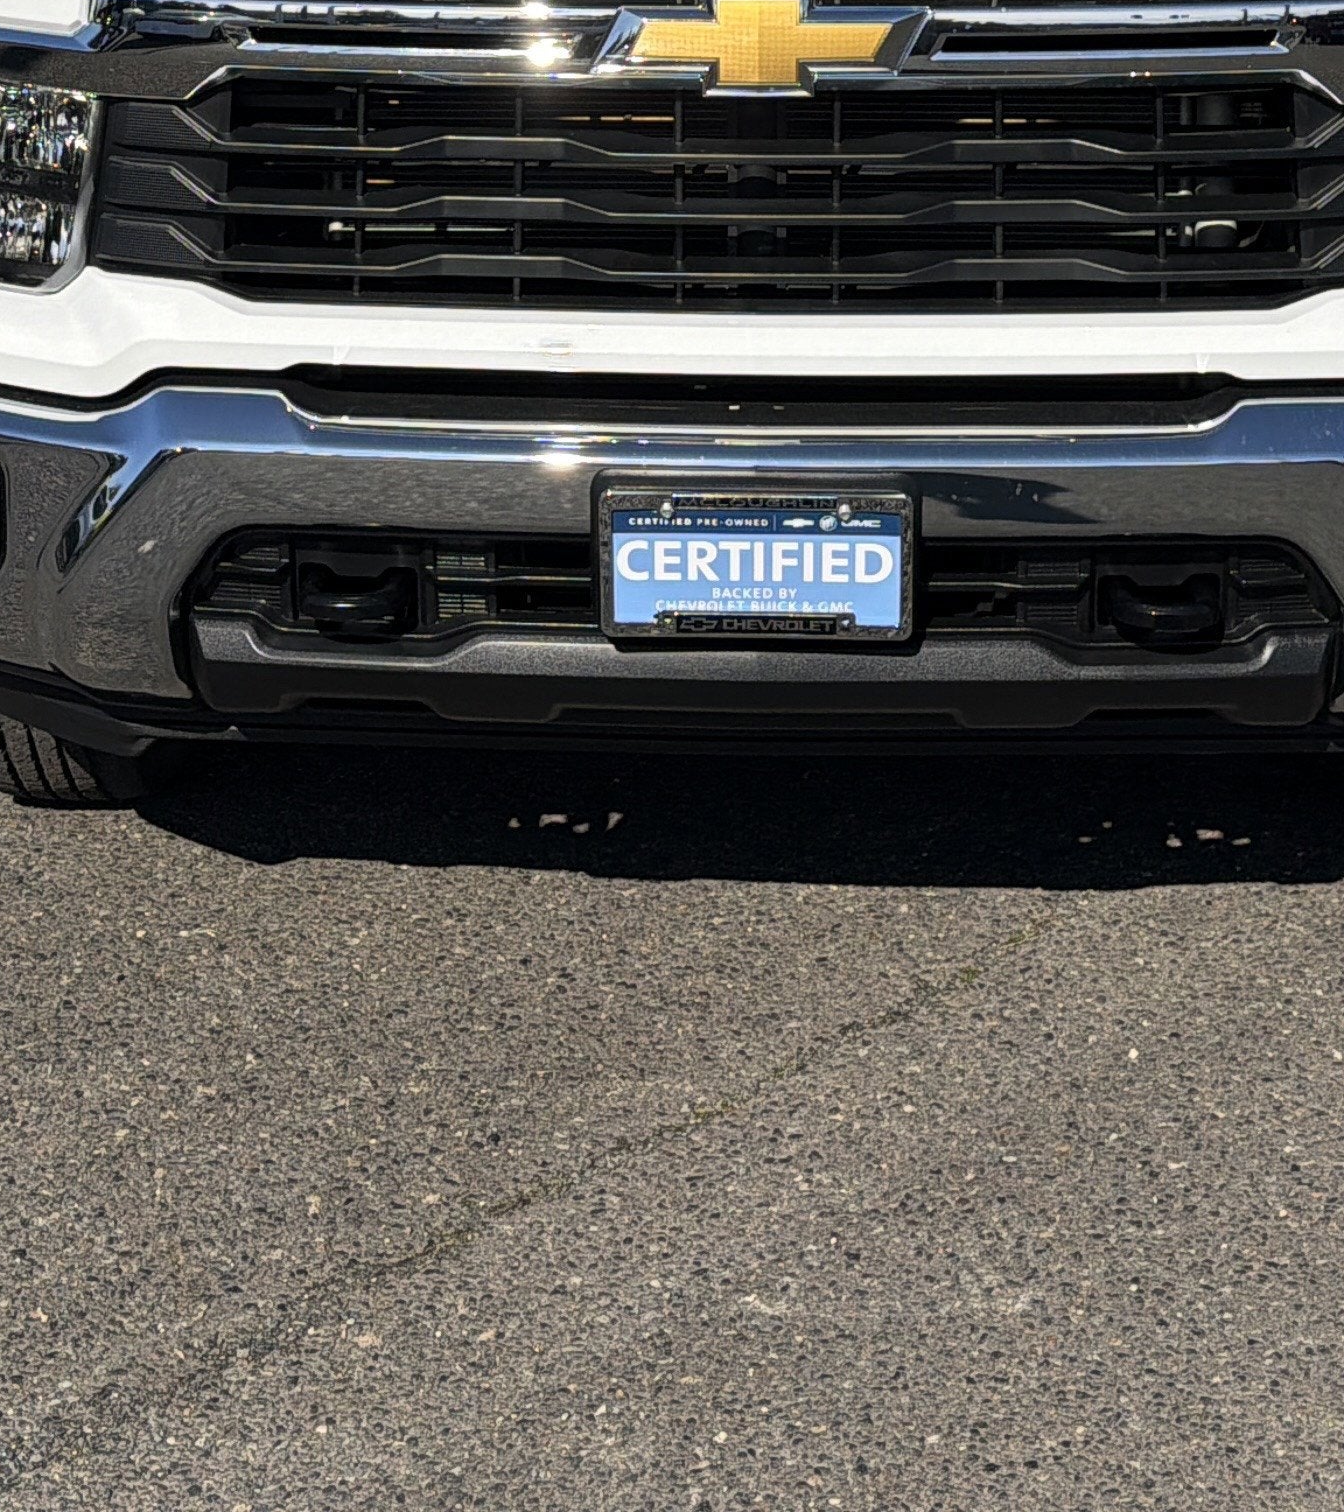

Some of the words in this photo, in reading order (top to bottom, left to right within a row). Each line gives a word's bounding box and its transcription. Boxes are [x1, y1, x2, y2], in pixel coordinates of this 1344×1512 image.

[696, 518, 769, 527] PRE-OWNED
[616, 539, 894, 584] CERTIFIED
[712, 587, 773, 599] BACKED
[778, 588, 798, 599] BY
[750, 600, 797, 612] BUICK
[802, 601, 814, 613] &
[817, 601, 854, 613] GMC
[722, 619, 834, 631] CHEVROLET
